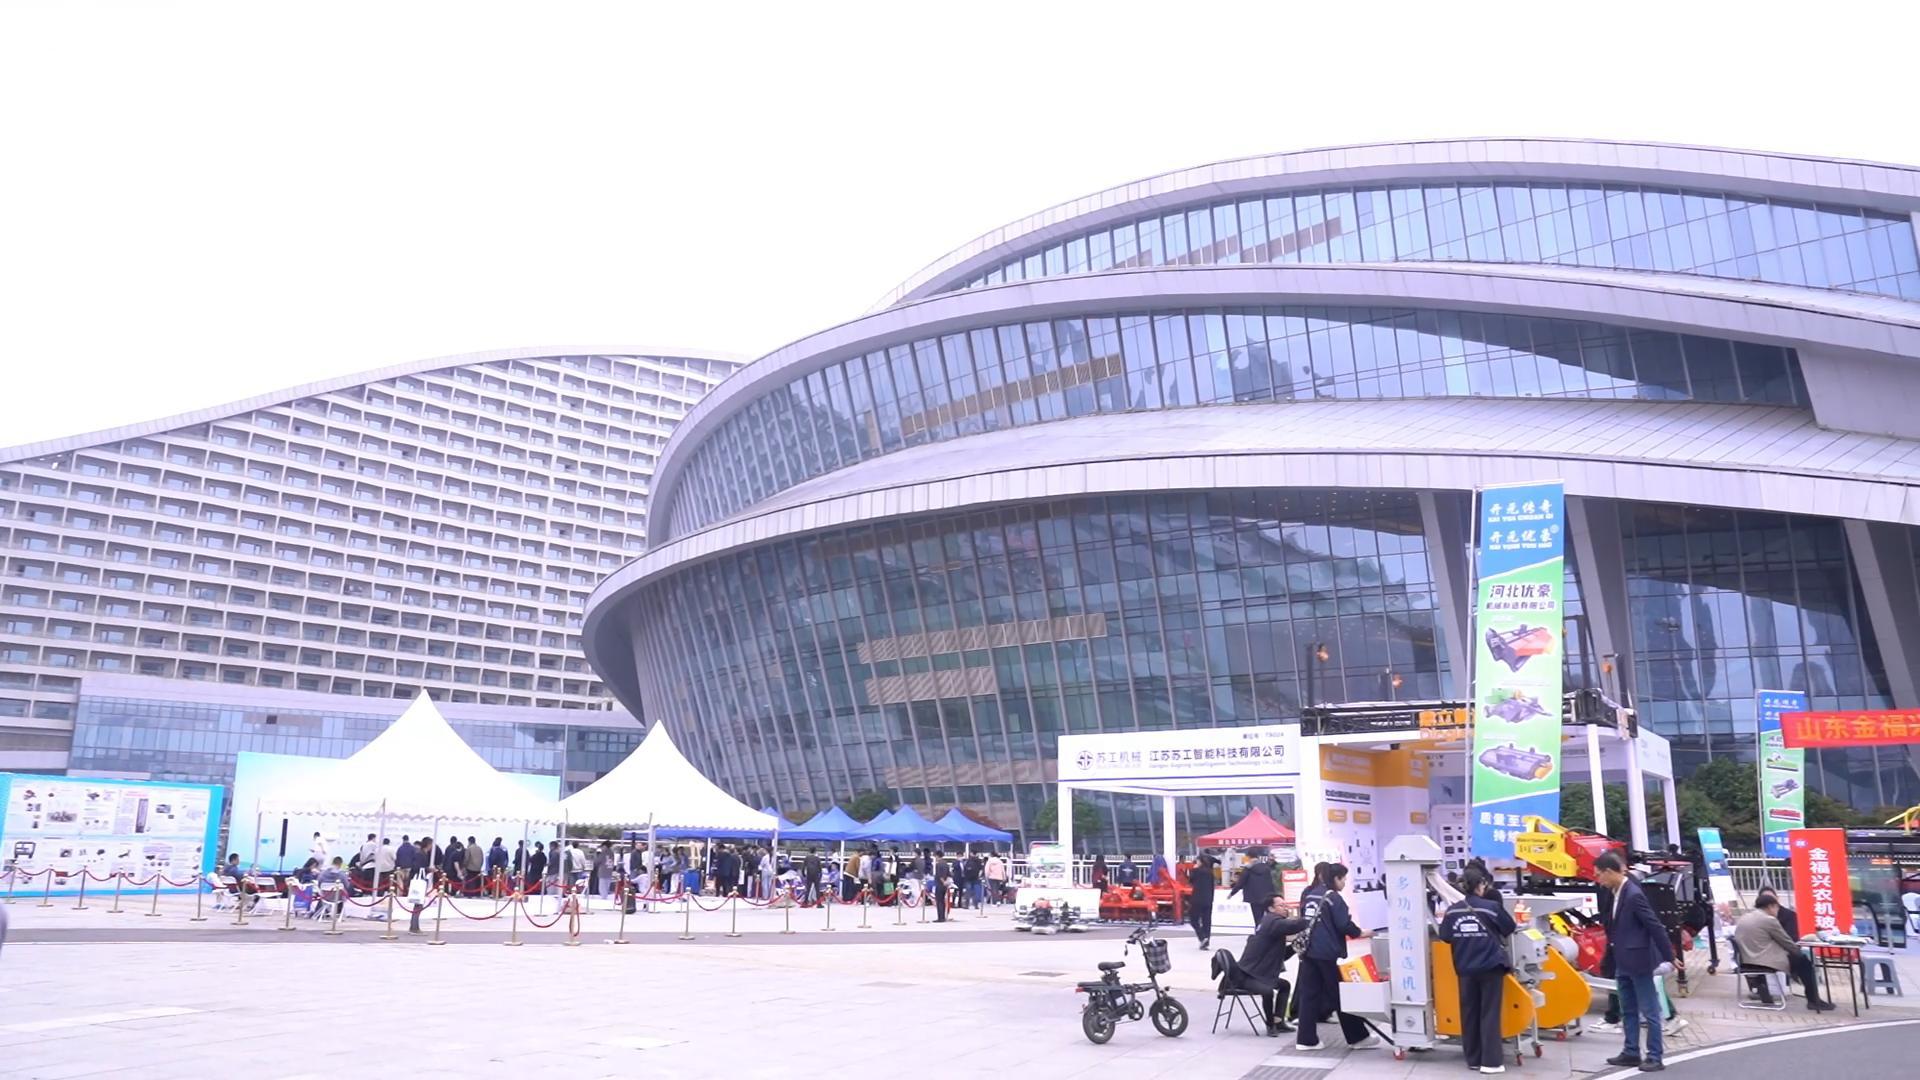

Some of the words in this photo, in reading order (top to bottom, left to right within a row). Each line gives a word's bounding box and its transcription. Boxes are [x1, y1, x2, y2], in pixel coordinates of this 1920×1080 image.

[1489, 584, 1551, 598] 河北优豪
[1096, 751, 1142, 763] 苏工机械
[1149, 744, 1285, 762] 江苏苏工智能科技有限公司
